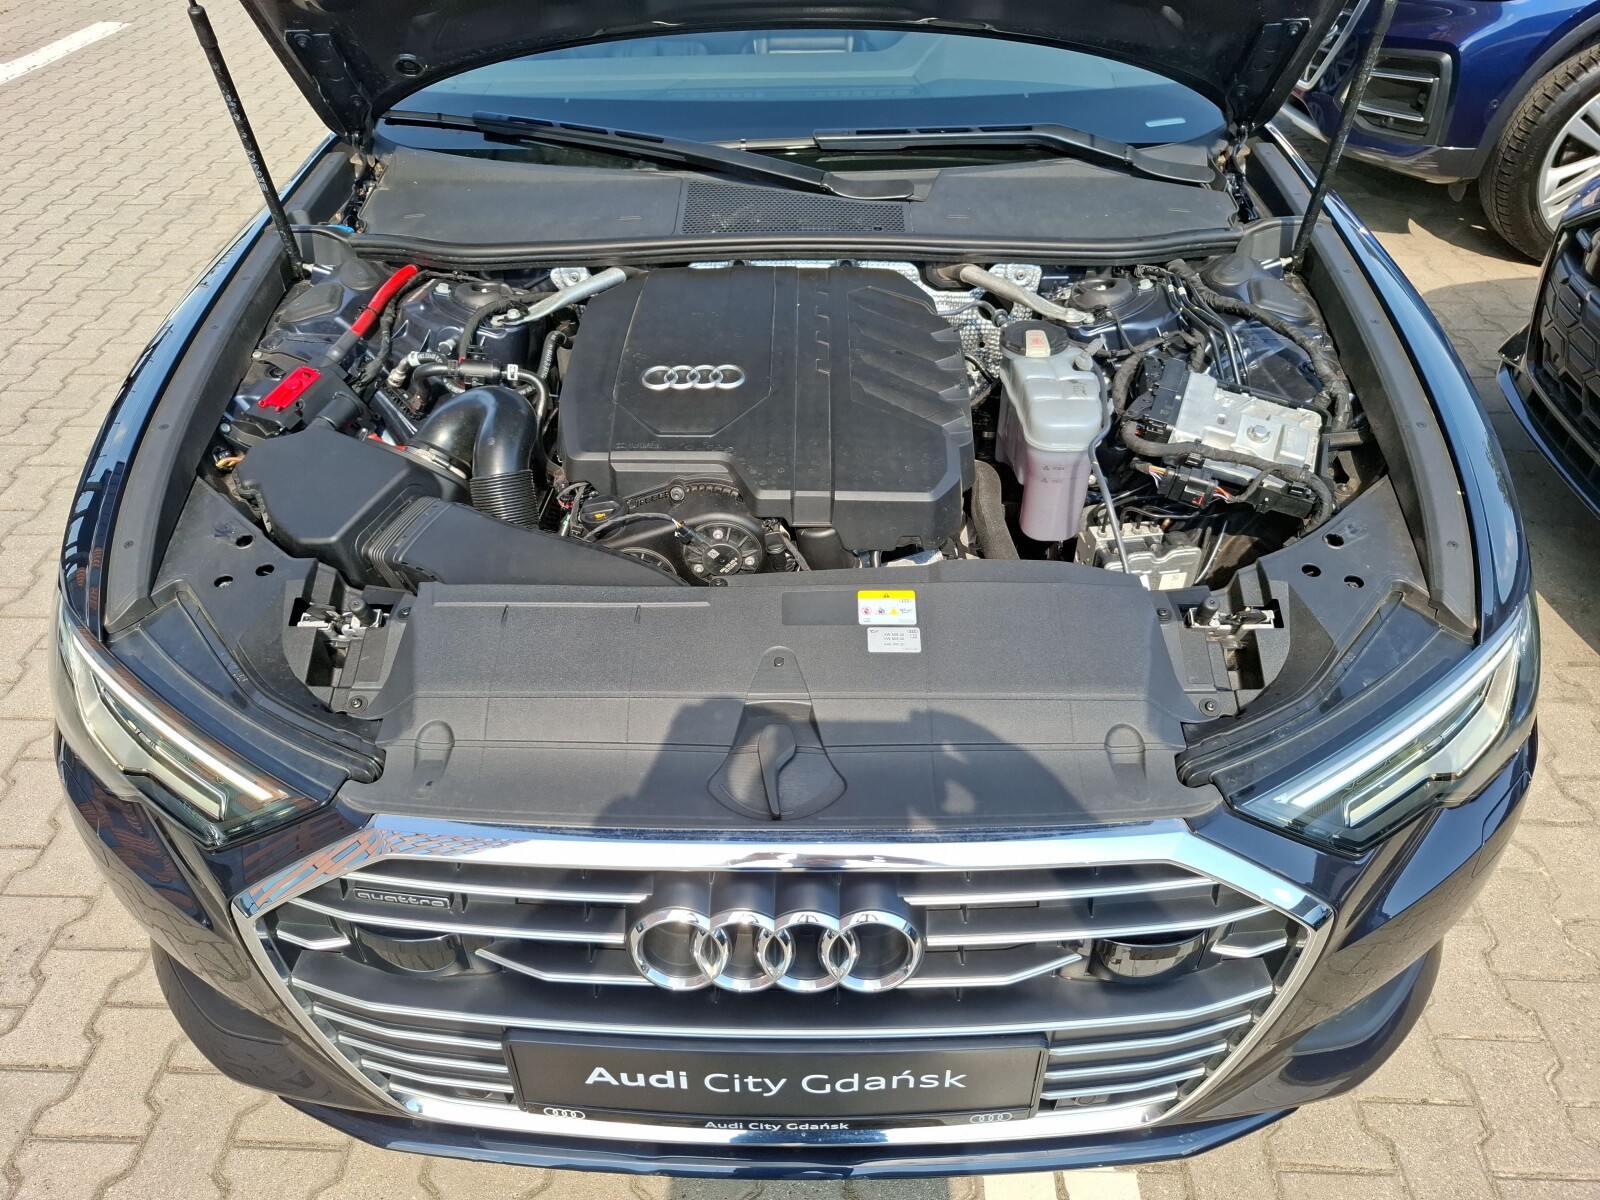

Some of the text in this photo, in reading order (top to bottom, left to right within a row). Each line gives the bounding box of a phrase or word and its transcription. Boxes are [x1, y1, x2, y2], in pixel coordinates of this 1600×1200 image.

[357, 891, 445, 907] quattro
[584, 1066, 968, 1097] Audi City Gdańsk
[704, 1121, 850, 1132] Audi City Gdańsk
